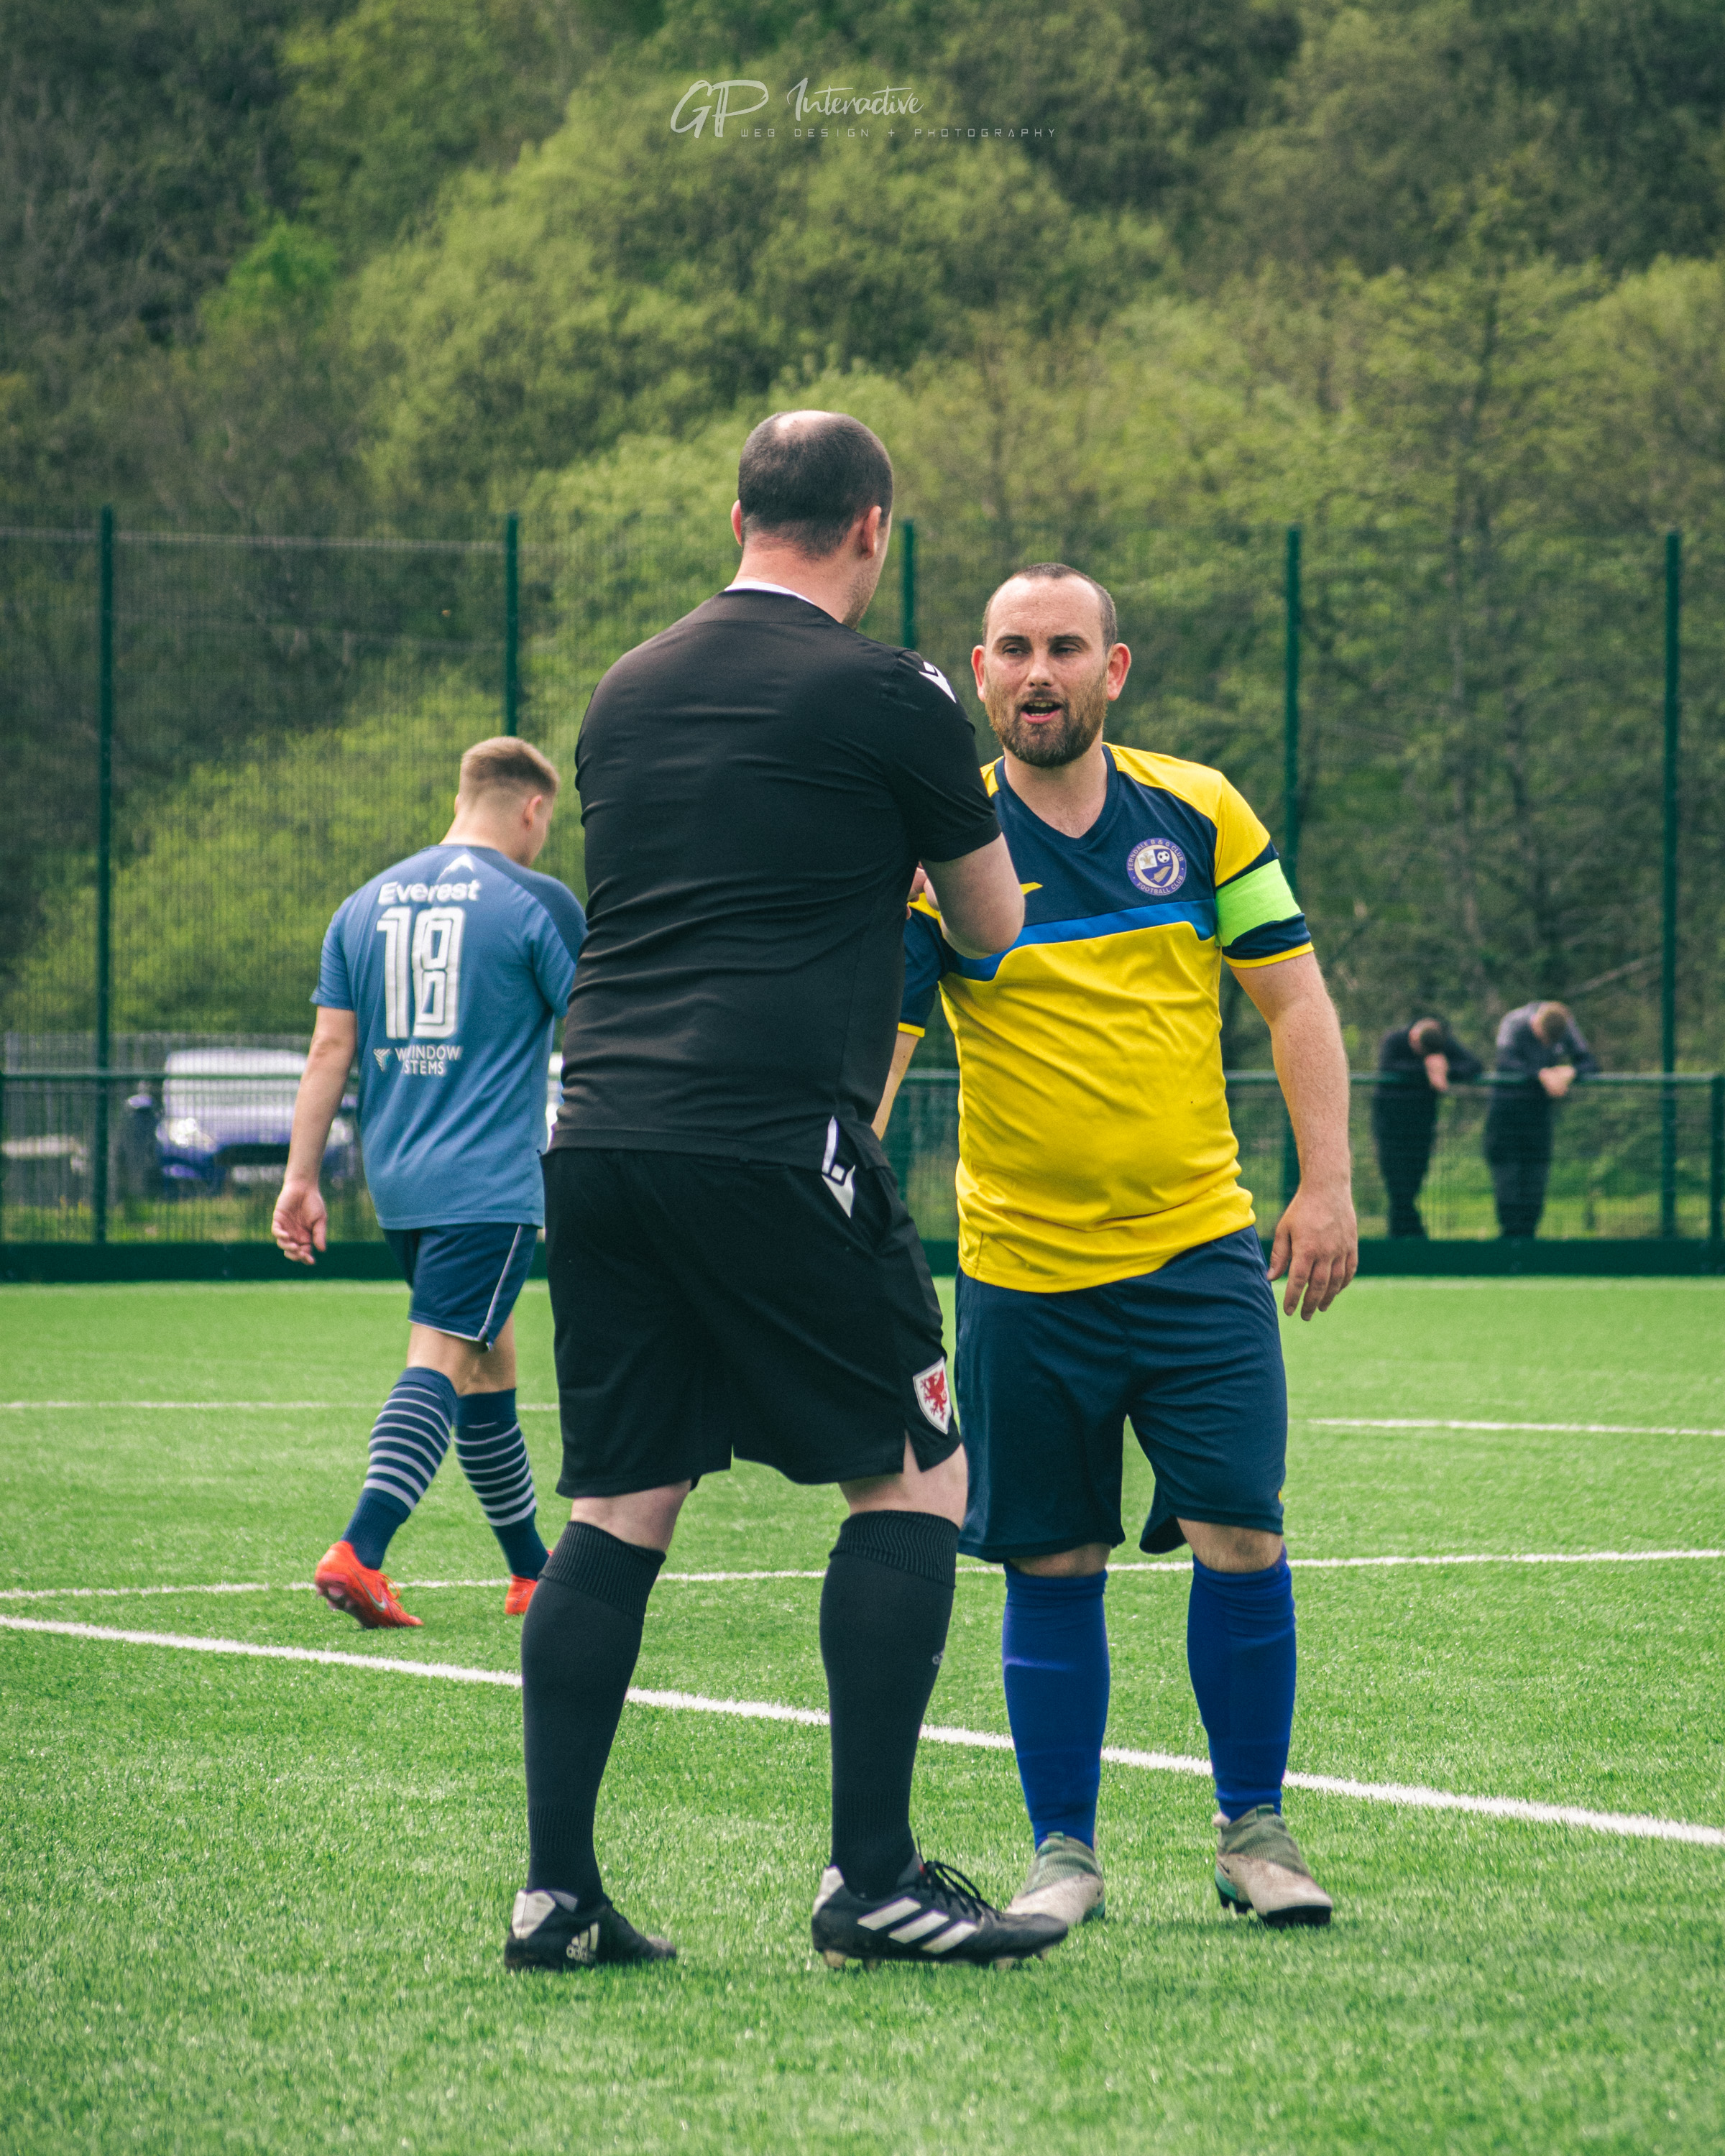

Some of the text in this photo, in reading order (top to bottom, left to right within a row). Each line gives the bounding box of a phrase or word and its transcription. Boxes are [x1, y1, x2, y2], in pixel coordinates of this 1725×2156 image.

[1128, 842, 1149, 871] FERNDALE
[1171, 845, 1184, 862] CLUB
[378, 880, 480, 904] Everest
[1136, 875, 1184, 894] FOOTBALL CLUB
[376, 906, 465, 1039] 18
[395, 1044, 461, 1061] WINDOW
